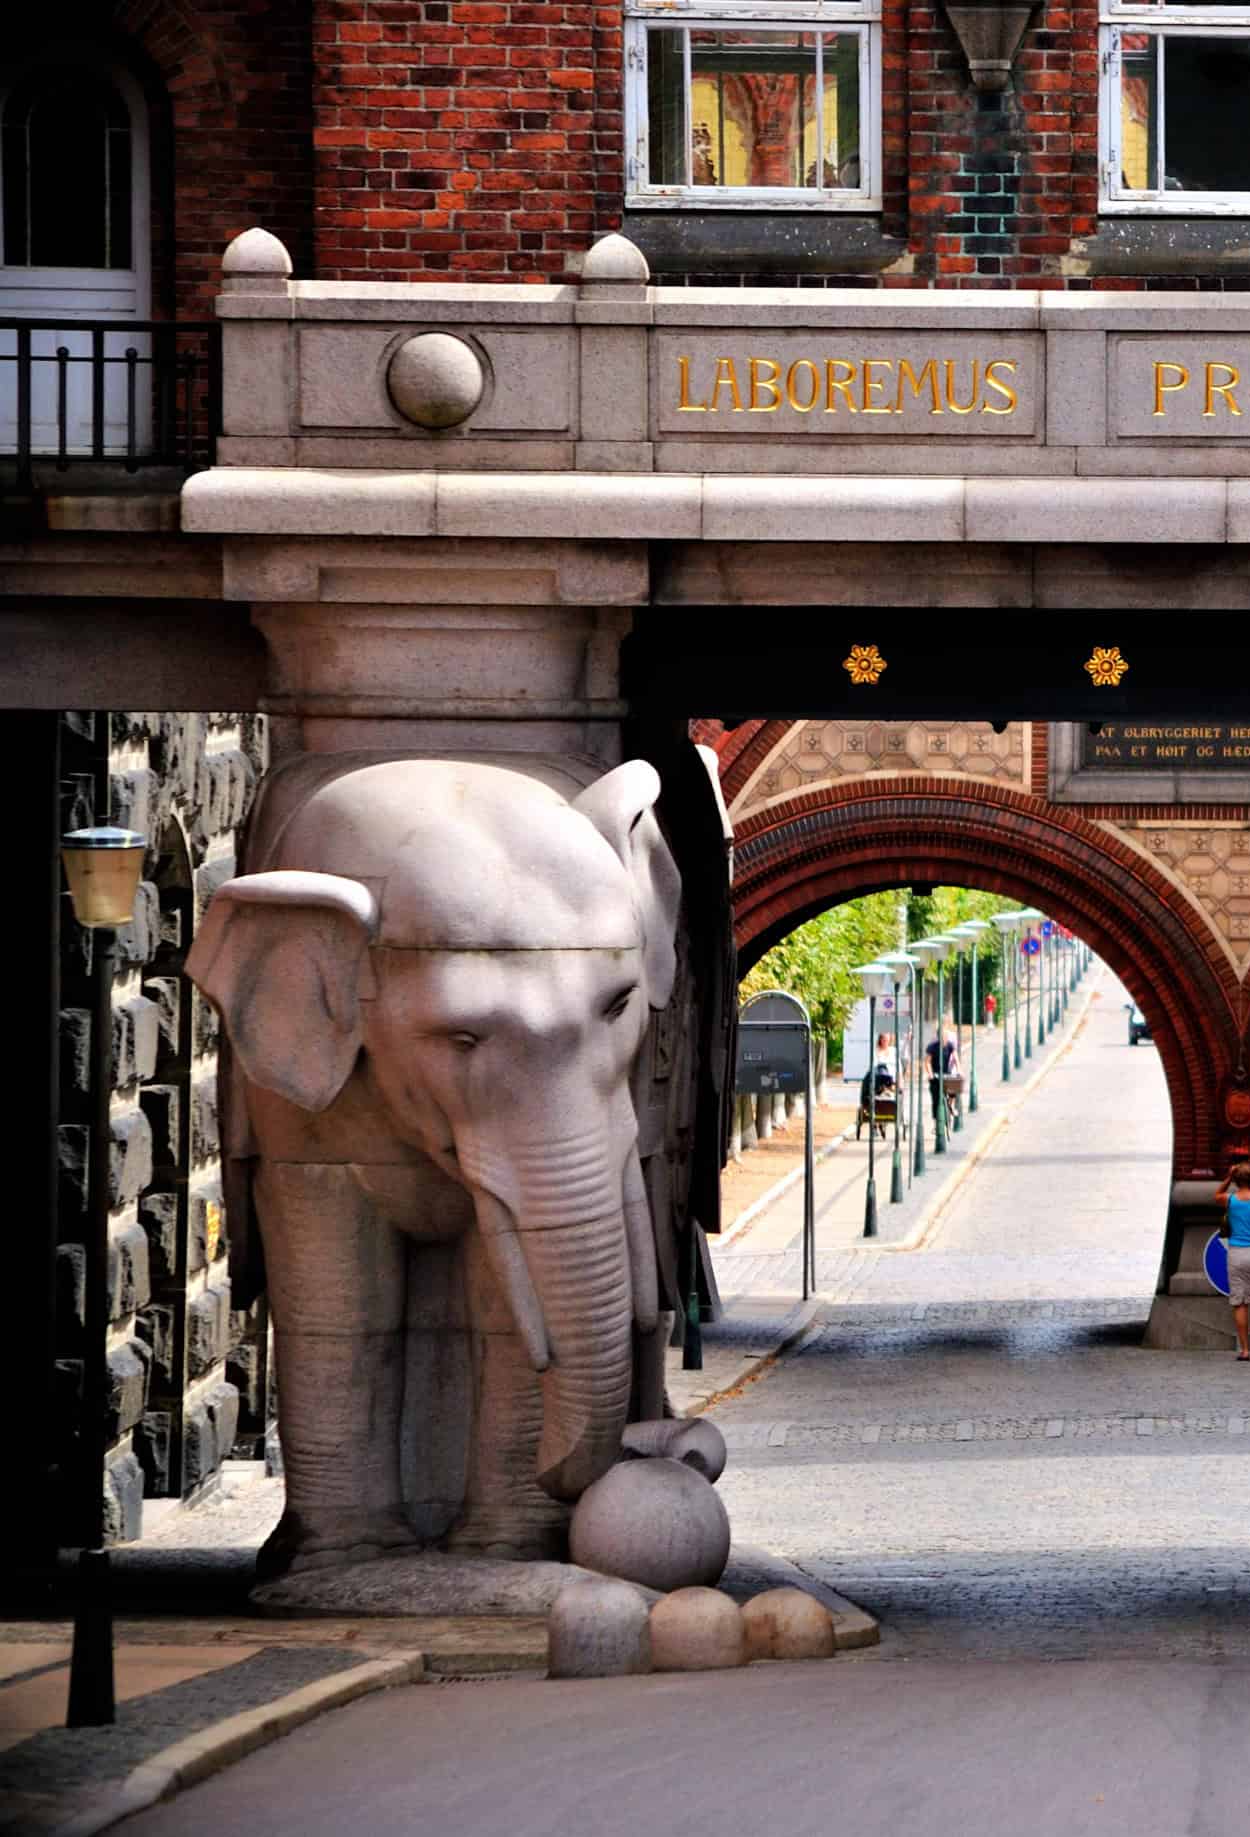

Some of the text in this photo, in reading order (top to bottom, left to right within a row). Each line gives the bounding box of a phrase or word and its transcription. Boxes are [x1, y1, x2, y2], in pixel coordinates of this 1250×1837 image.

[677, 356, 1018, 416] LABOREMUS
[1124, 727, 1222, 739] ØLBRYGGERIET
[1095, 745, 1121, 757] PAA
[1130, 745, 1147, 757] ET
[1196, 745, 1215, 757] OG
